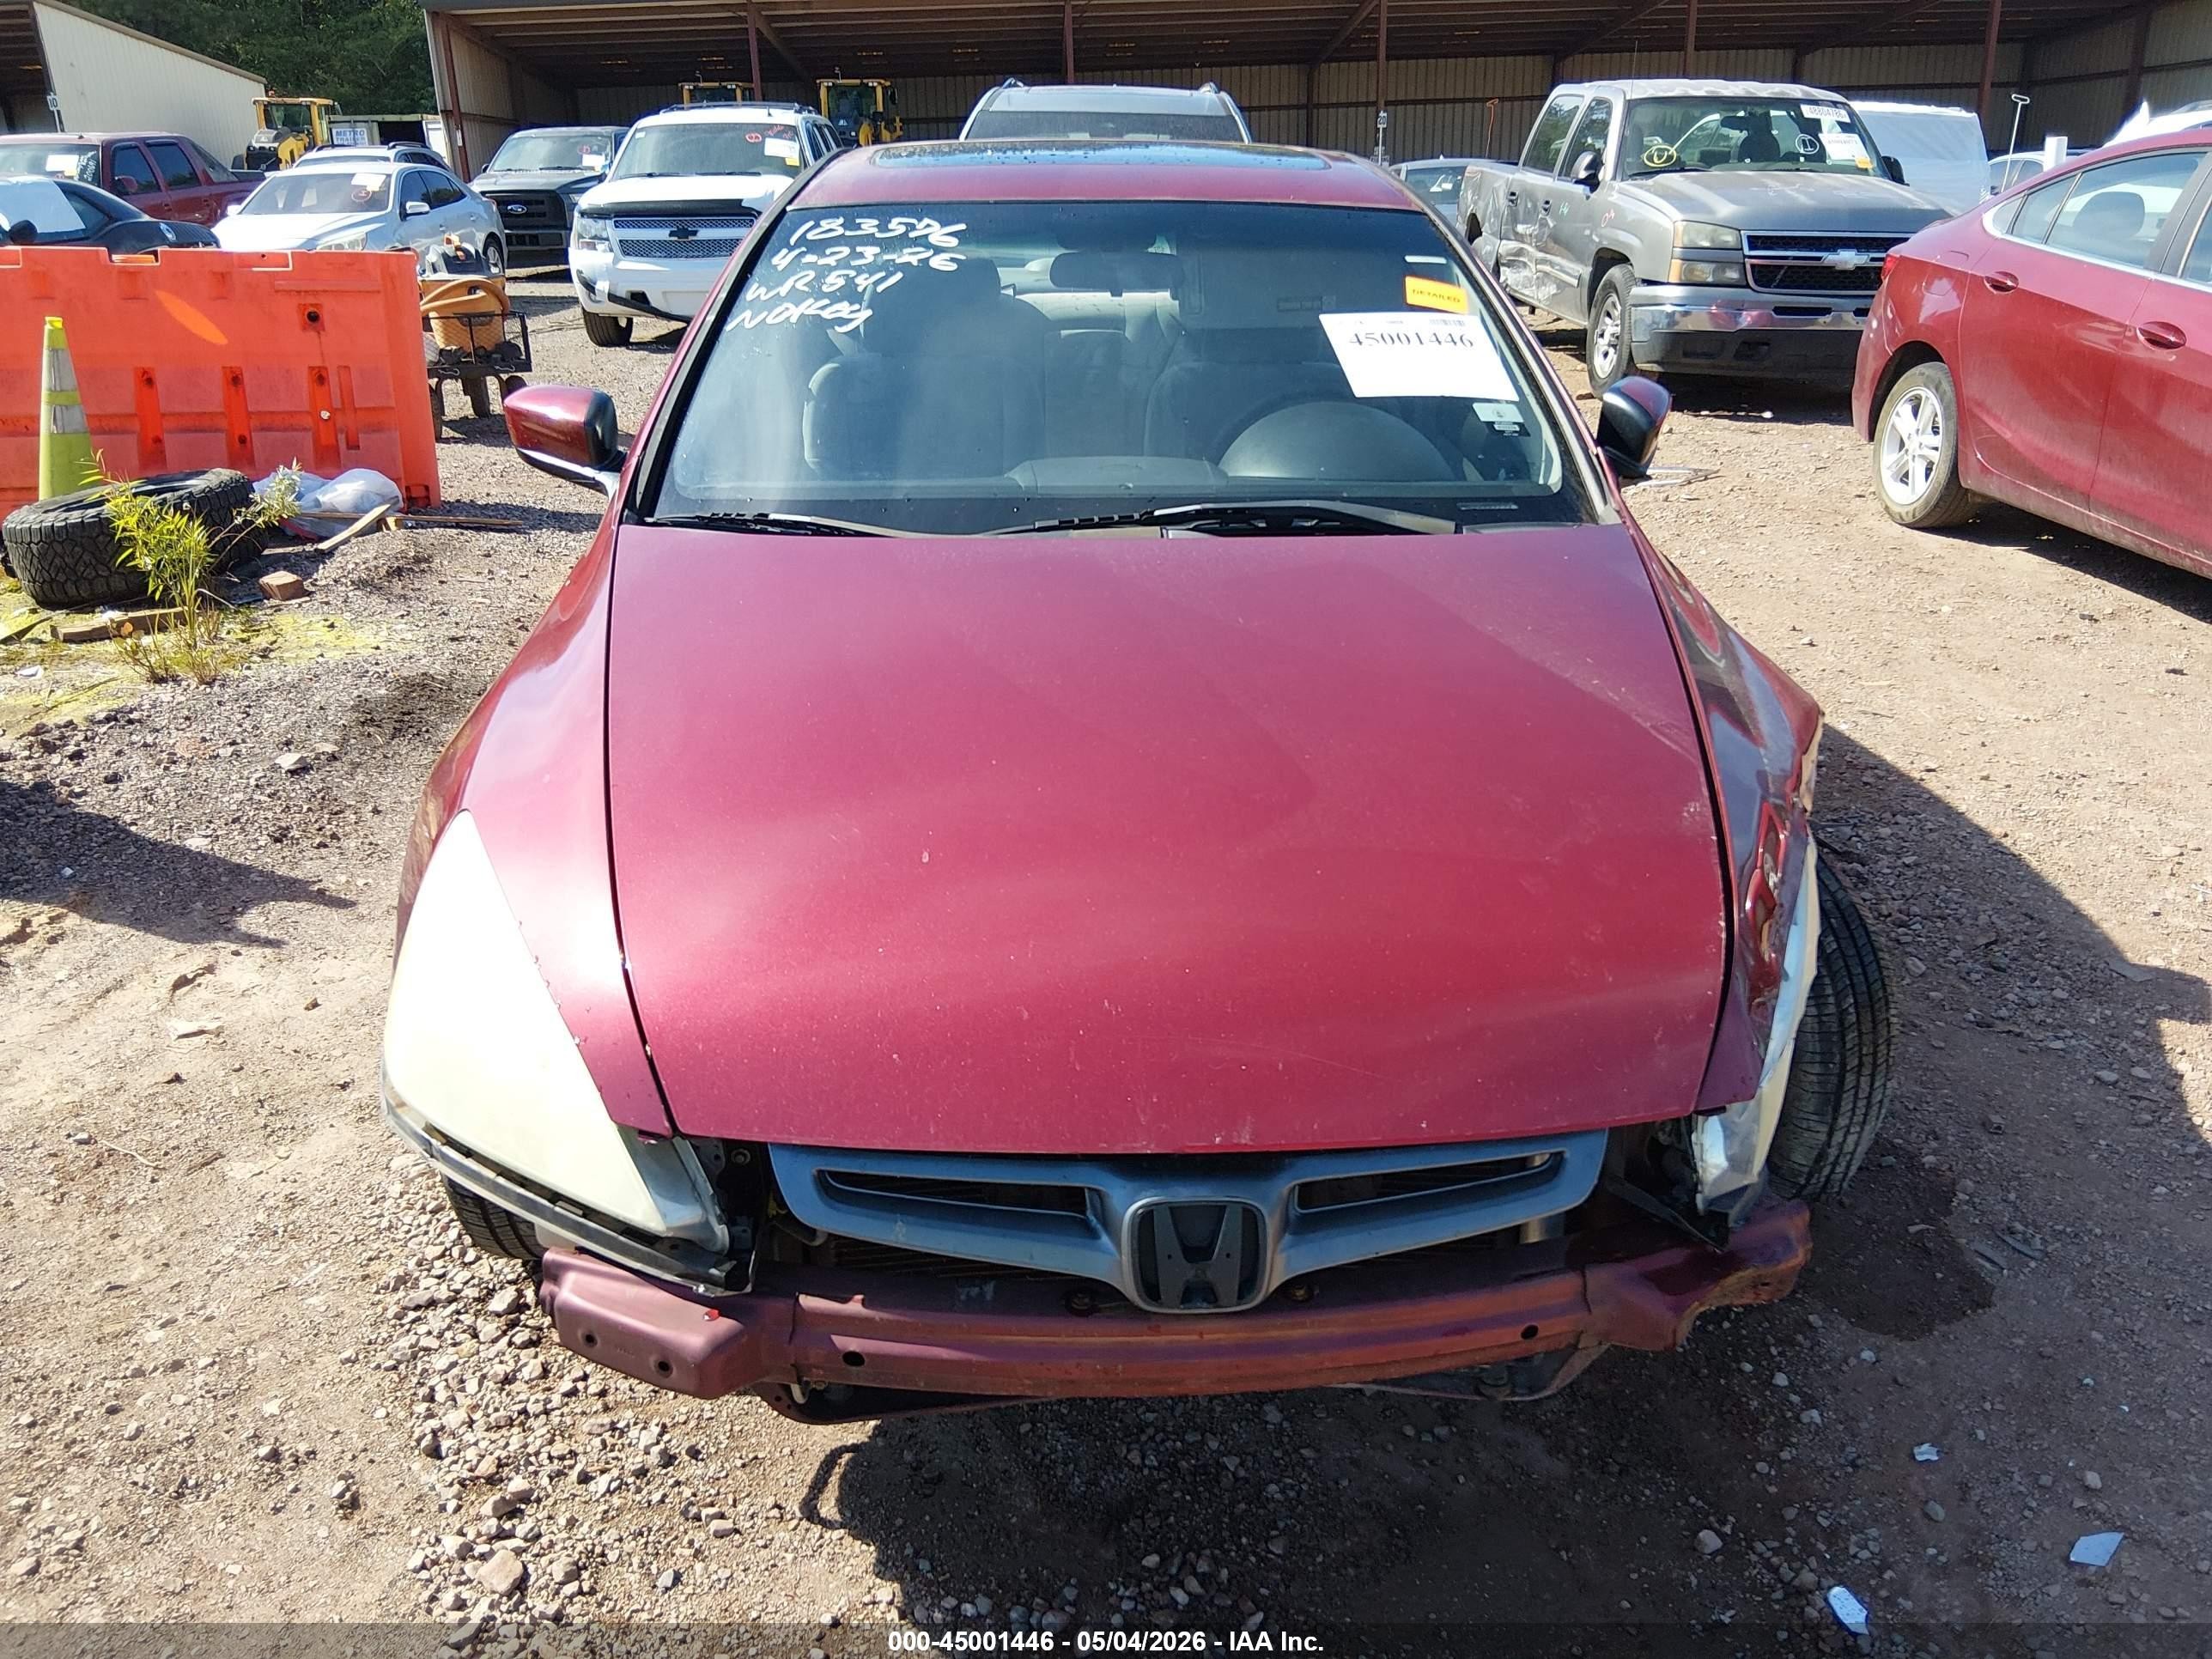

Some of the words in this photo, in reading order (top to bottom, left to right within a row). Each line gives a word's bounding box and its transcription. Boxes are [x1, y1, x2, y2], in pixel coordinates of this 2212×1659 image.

[1378, 115, 1387, 125] 20
[1413, 289, 1462, 303] DETAILED
[1349, 331, 1474, 348] 45001446
